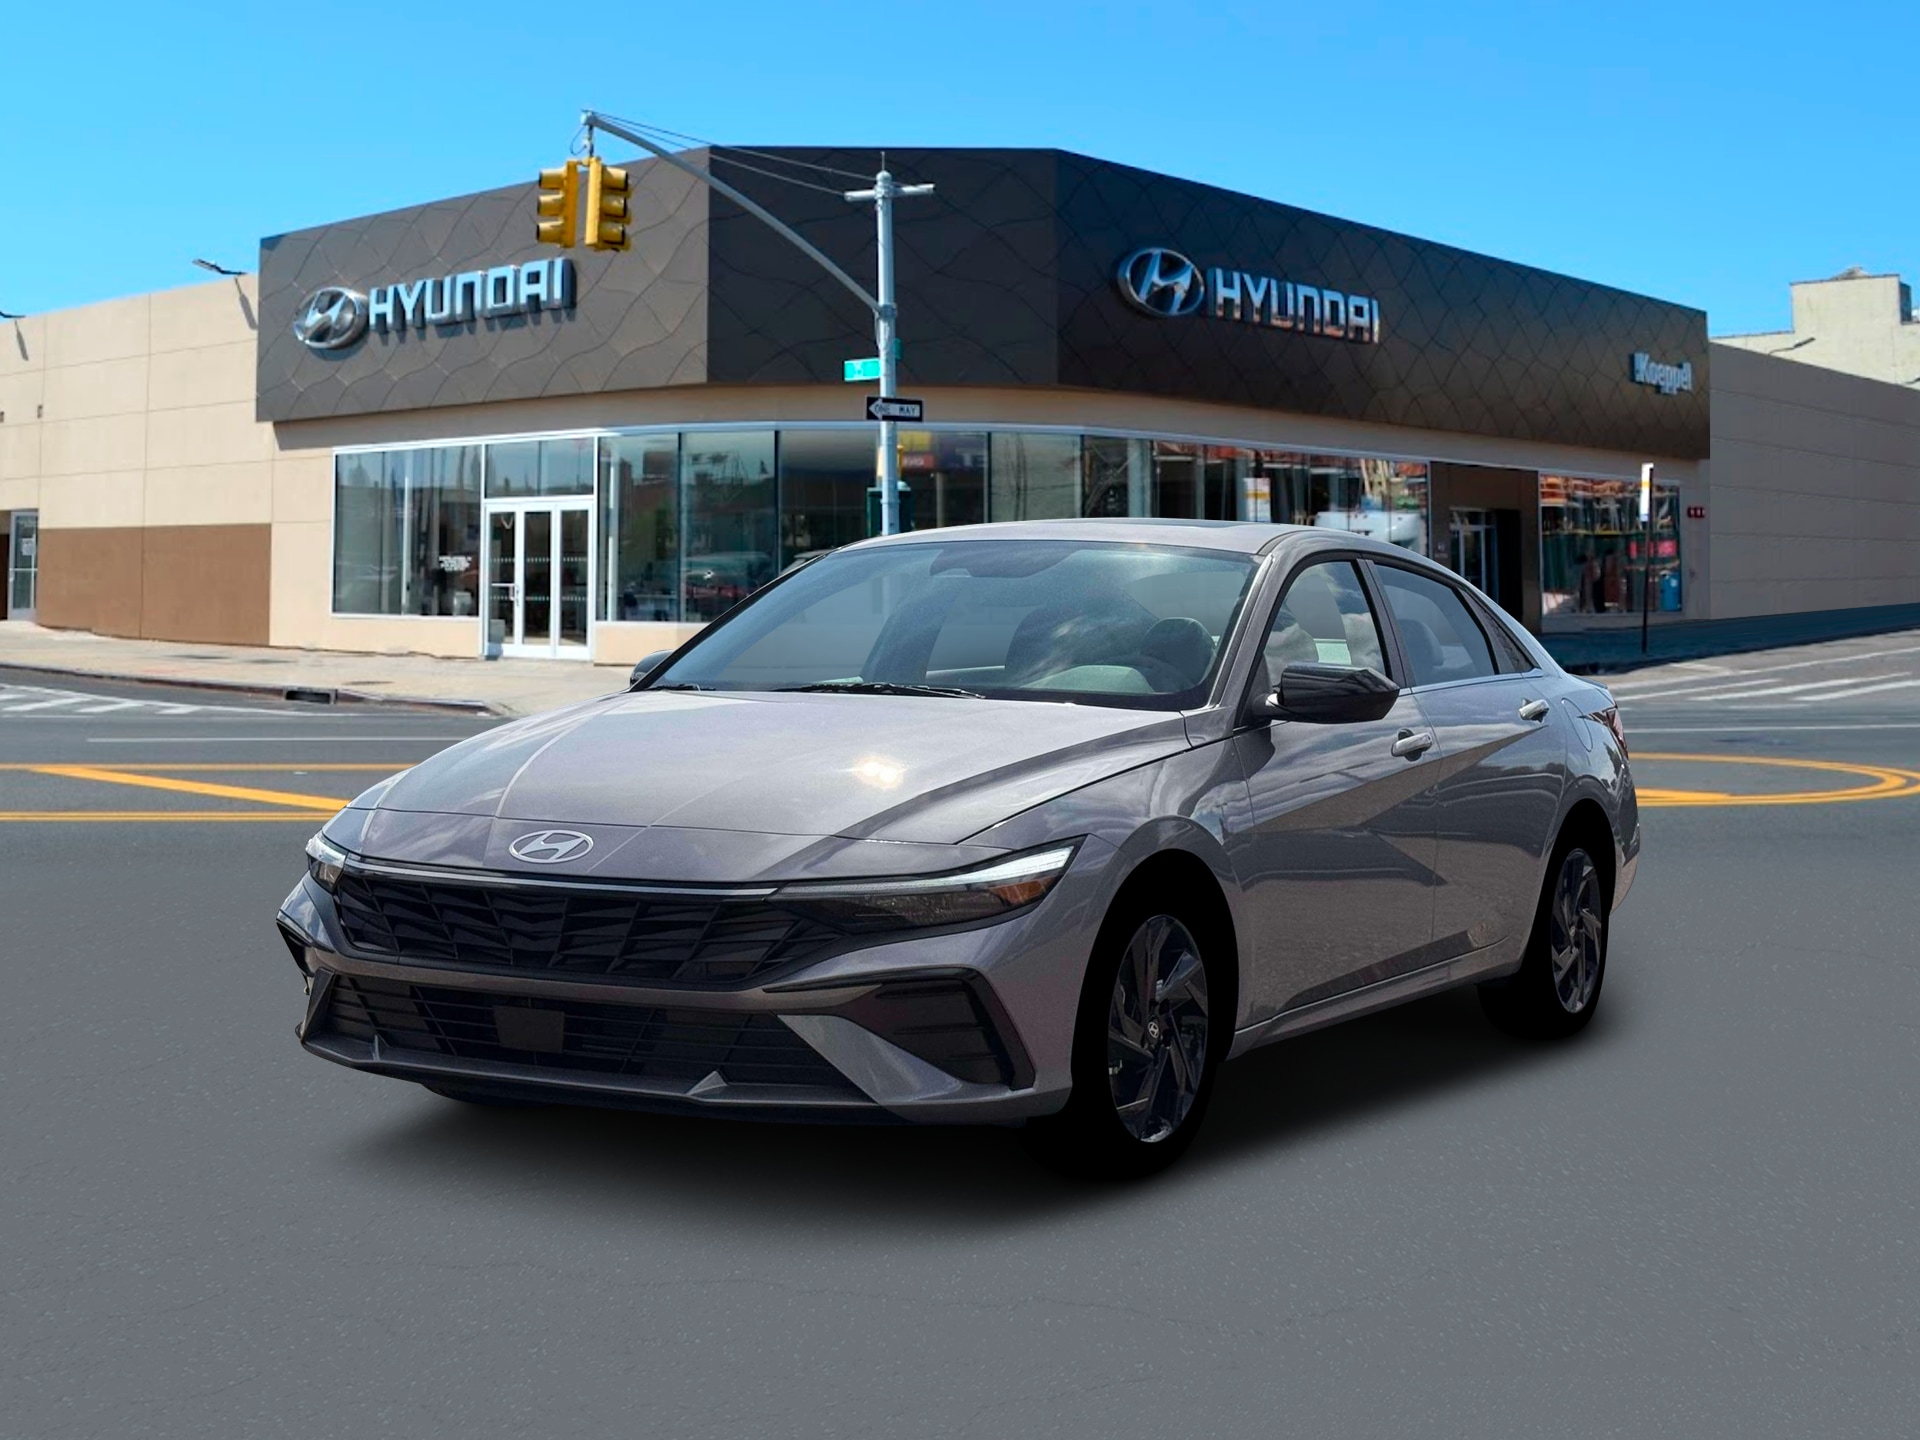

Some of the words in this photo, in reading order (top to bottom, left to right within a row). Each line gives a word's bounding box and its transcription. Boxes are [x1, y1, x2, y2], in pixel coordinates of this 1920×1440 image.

[369, 257, 570, 328] HYUNDAI
[1215, 268, 1380, 343] HYUNDAI
[1634, 352, 1692, 395] Koeppel
[874, 403, 891, 415] ONE
[899, 404, 917, 414] WAY
